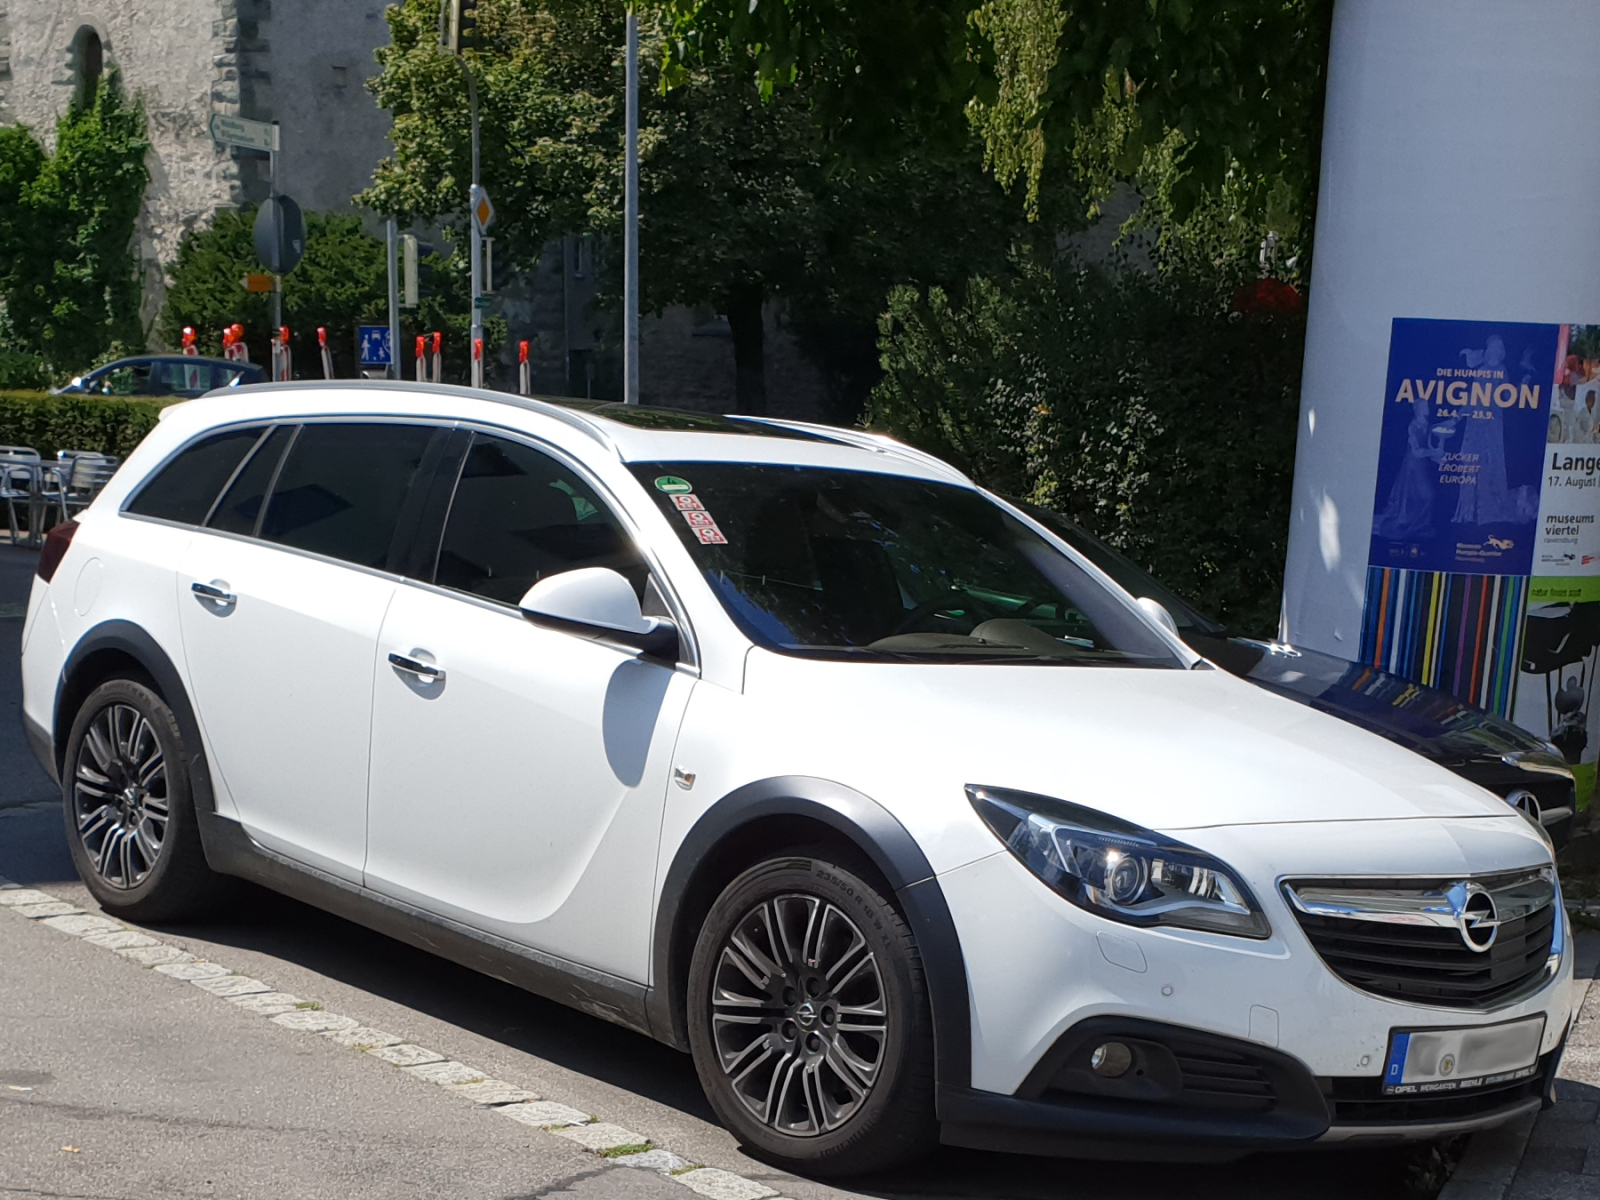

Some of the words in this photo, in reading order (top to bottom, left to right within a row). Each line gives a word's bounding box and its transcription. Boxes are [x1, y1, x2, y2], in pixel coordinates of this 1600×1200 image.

[1436, 367, 1453, 377] DIE
[1454, 369, 1492, 379] HUMPIS
[1493, 370, 1504, 379] IN
[1395, 378, 1541, 410] AVIGNON
[1442, 452, 1480, 463] ZUCKER
[1438, 463, 1481, 473] EROBERT
[1439, 474, 1477, 485] EUROPA
[1548, 476, 1562, 487] 17.
[1565, 477, 1596, 490] August
[1546, 515, 1595, 524] museums
[1545, 525, 1580, 536] viertel
[1391, 1064, 1398, 1075] D
